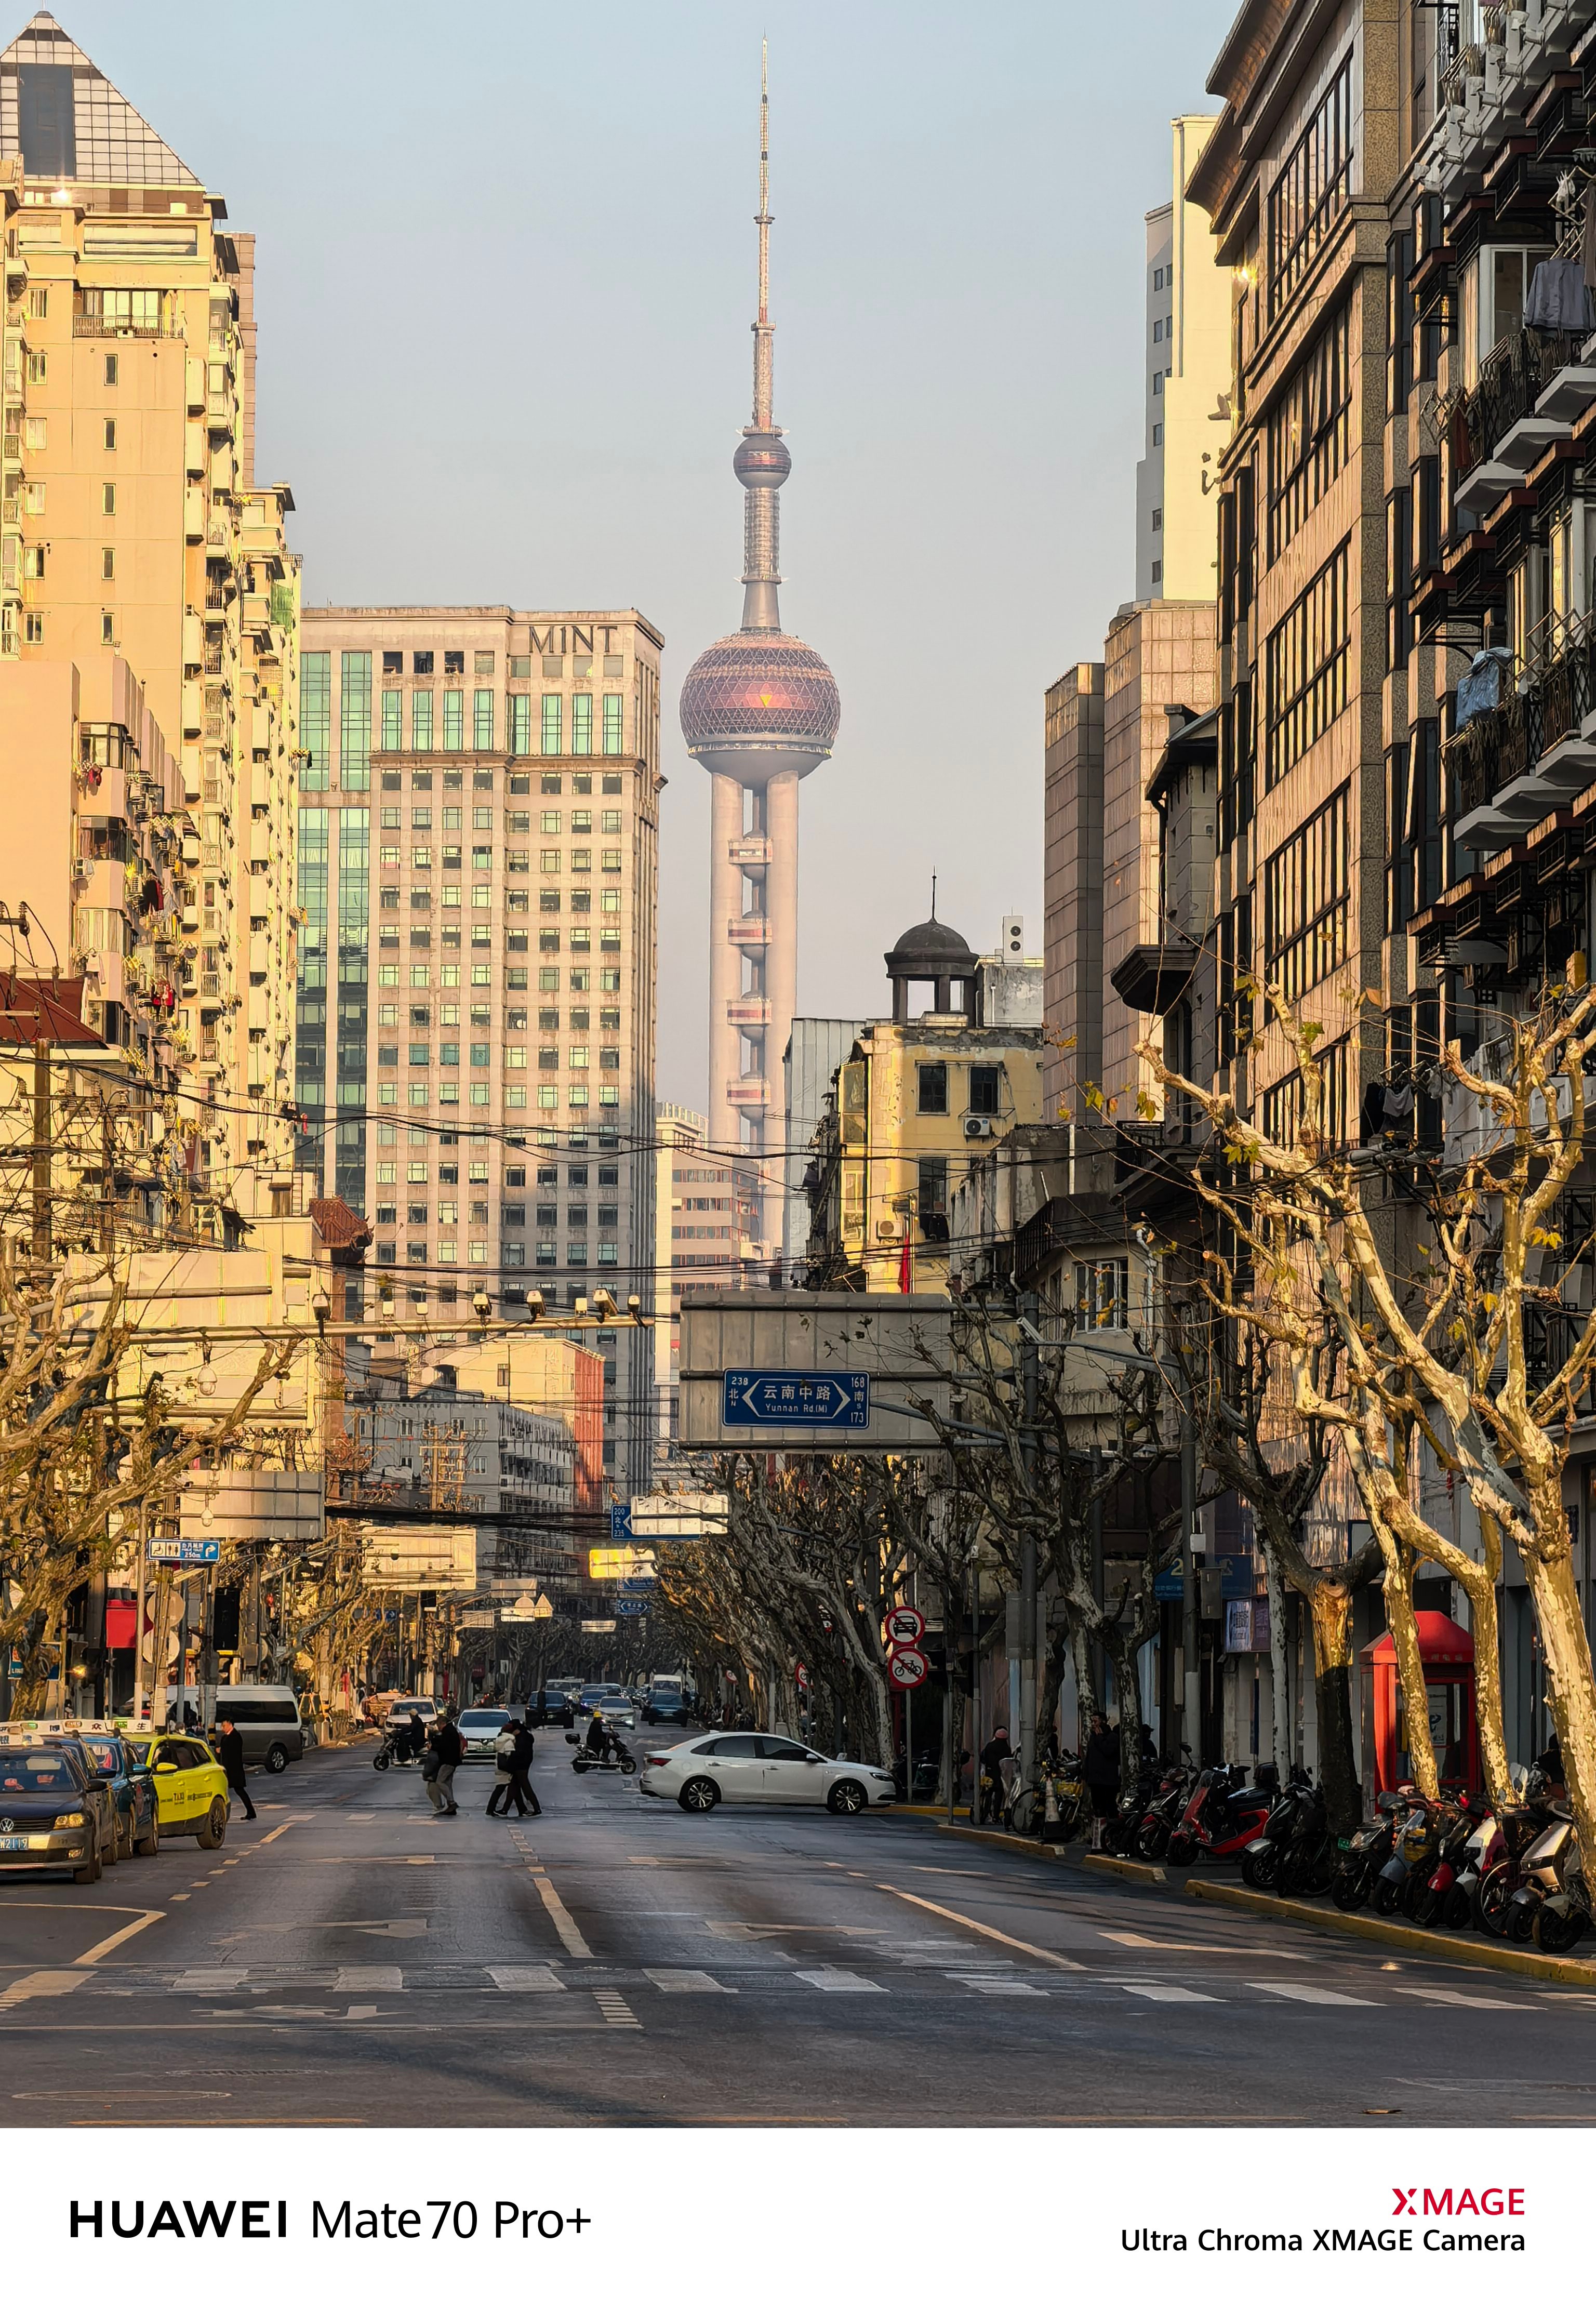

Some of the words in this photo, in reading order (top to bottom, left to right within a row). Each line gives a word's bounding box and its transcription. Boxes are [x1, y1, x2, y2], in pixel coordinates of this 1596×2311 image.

[529, 626, 617, 653] MINT
[732, 1377, 748, 1386] 238
[852, 1377, 864, 1388] 168
[728, 1388, 739, 1399] 北
[764, 1385, 831, 1401] 云南中路
[854, 1390, 864, 1402] 南
[765, 1403, 799, 1412] Yunnan
[851, 1412, 863, 1423] 173
